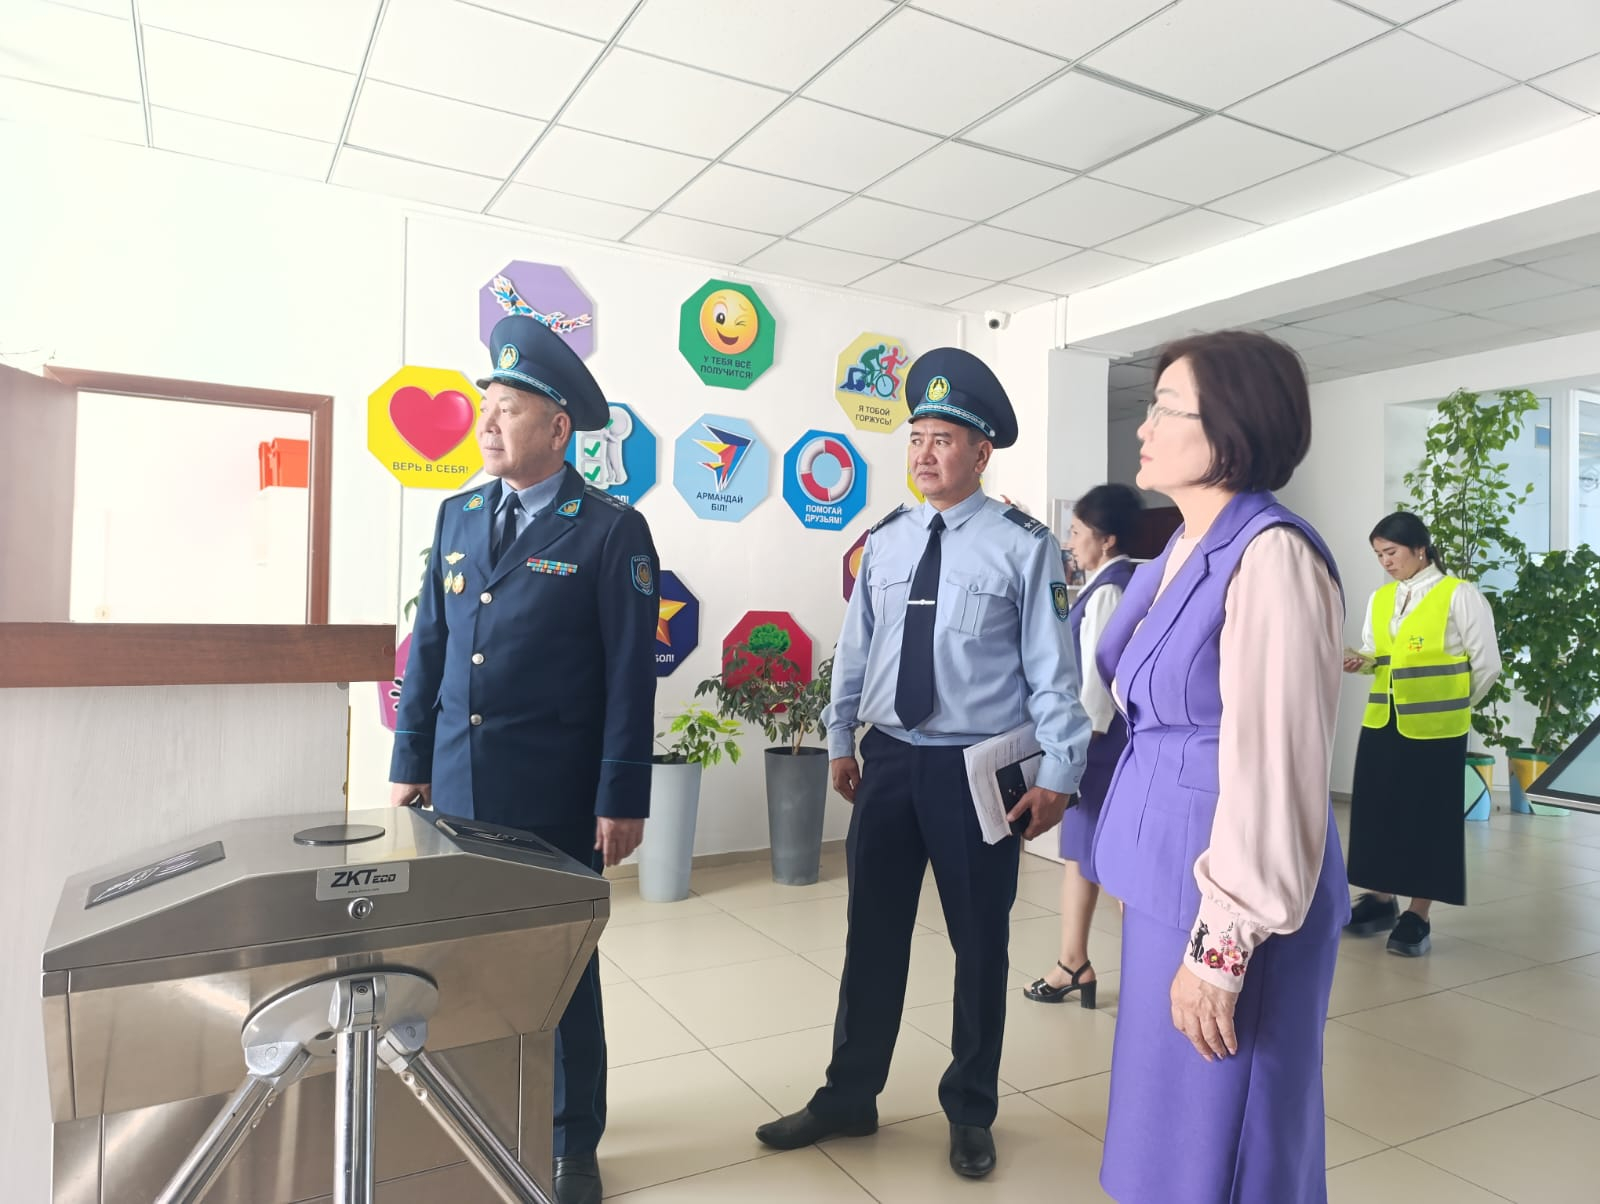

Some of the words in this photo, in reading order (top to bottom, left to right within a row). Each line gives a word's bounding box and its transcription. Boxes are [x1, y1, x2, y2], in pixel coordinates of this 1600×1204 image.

[703, 355, 709, 363] У
[711, 356, 733, 367] ТЕБЯ
[700, 364, 753, 380] ПОЛУЧИТСЯ!
[865, 406, 890, 416] ТОБОЙ
[855, 414, 892, 425] ГОРЖУСЬ!
[392, 461, 422, 472] ВЕРЬ
[425, 464, 433, 472] В
[436, 464, 469, 474] СЕБЯ!
[696, 491, 744, 504] АРМАНДАЙ
[805, 504, 843, 515] ПОМОГАЙ
[804, 513, 843, 525] ДРУЗЬЯМ!
